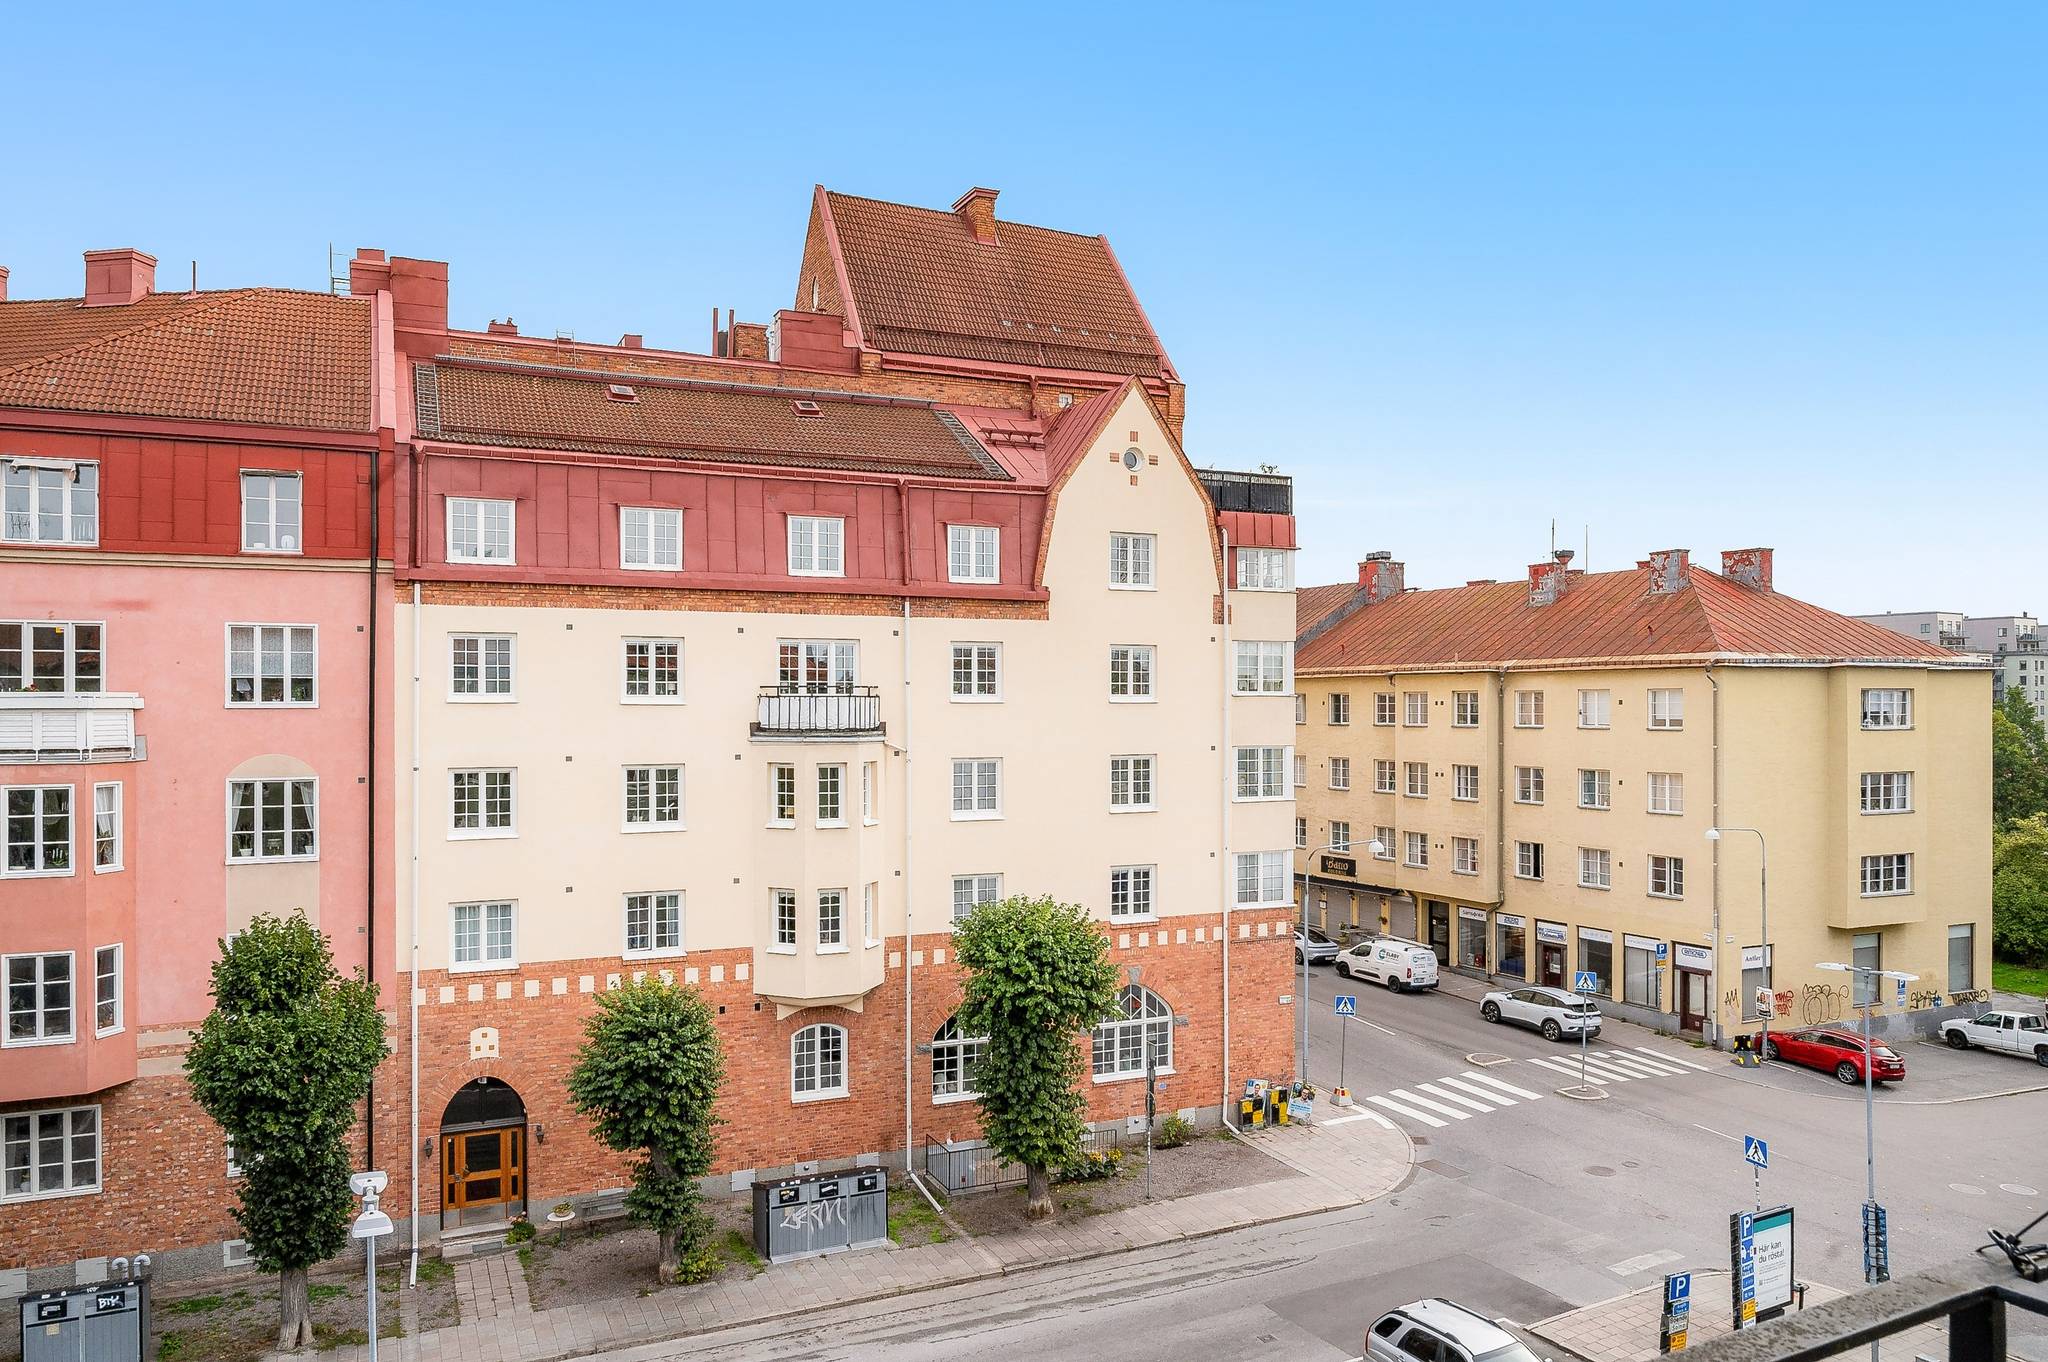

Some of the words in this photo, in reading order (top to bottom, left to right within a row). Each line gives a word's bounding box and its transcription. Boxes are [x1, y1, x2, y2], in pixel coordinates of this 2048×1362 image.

[1743, 1216, 1751, 1237] P
[1759, 1244, 1770, 1255] Här
[1770, 1241, 1782, 1251] kan
[1759, 1254, 1767, 1264] du
[1768, 1249, 1785, 1261] rösta!
[1676, 1277, 1686, 1298] P
